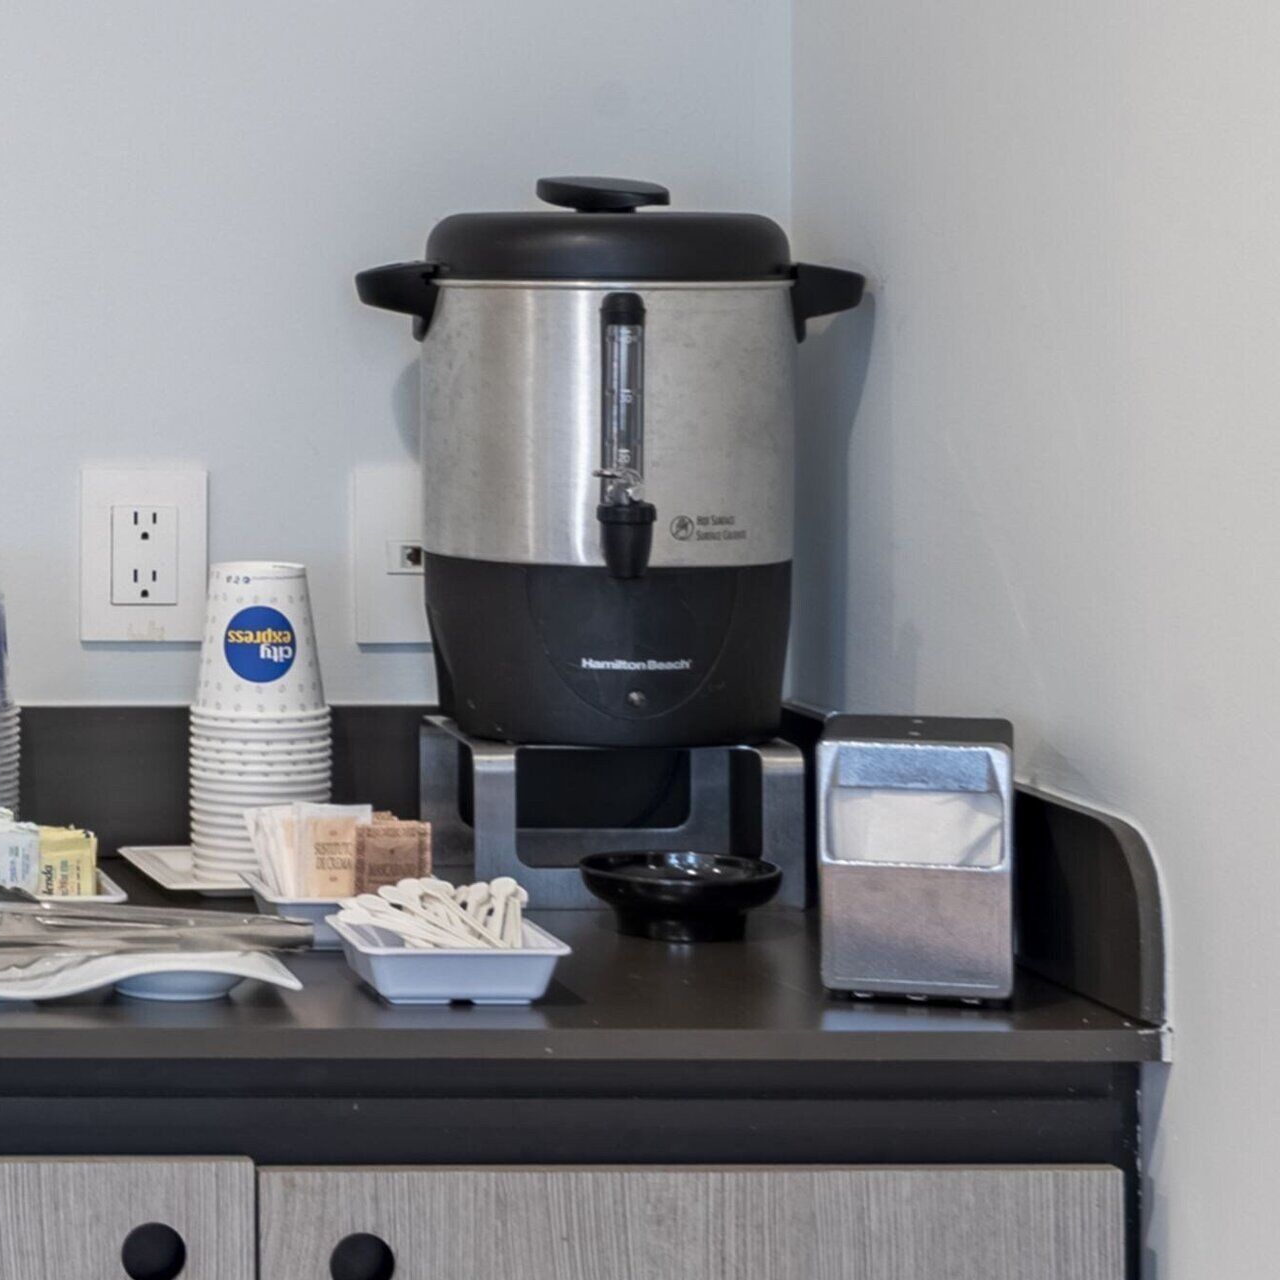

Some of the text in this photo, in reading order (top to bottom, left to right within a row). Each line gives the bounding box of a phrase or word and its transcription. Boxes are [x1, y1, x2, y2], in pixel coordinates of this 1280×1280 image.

[227, 627, 292, 643] express
[260, 643, 292, 663] city
[581, 657, 690, 670] Hamilton Beach
